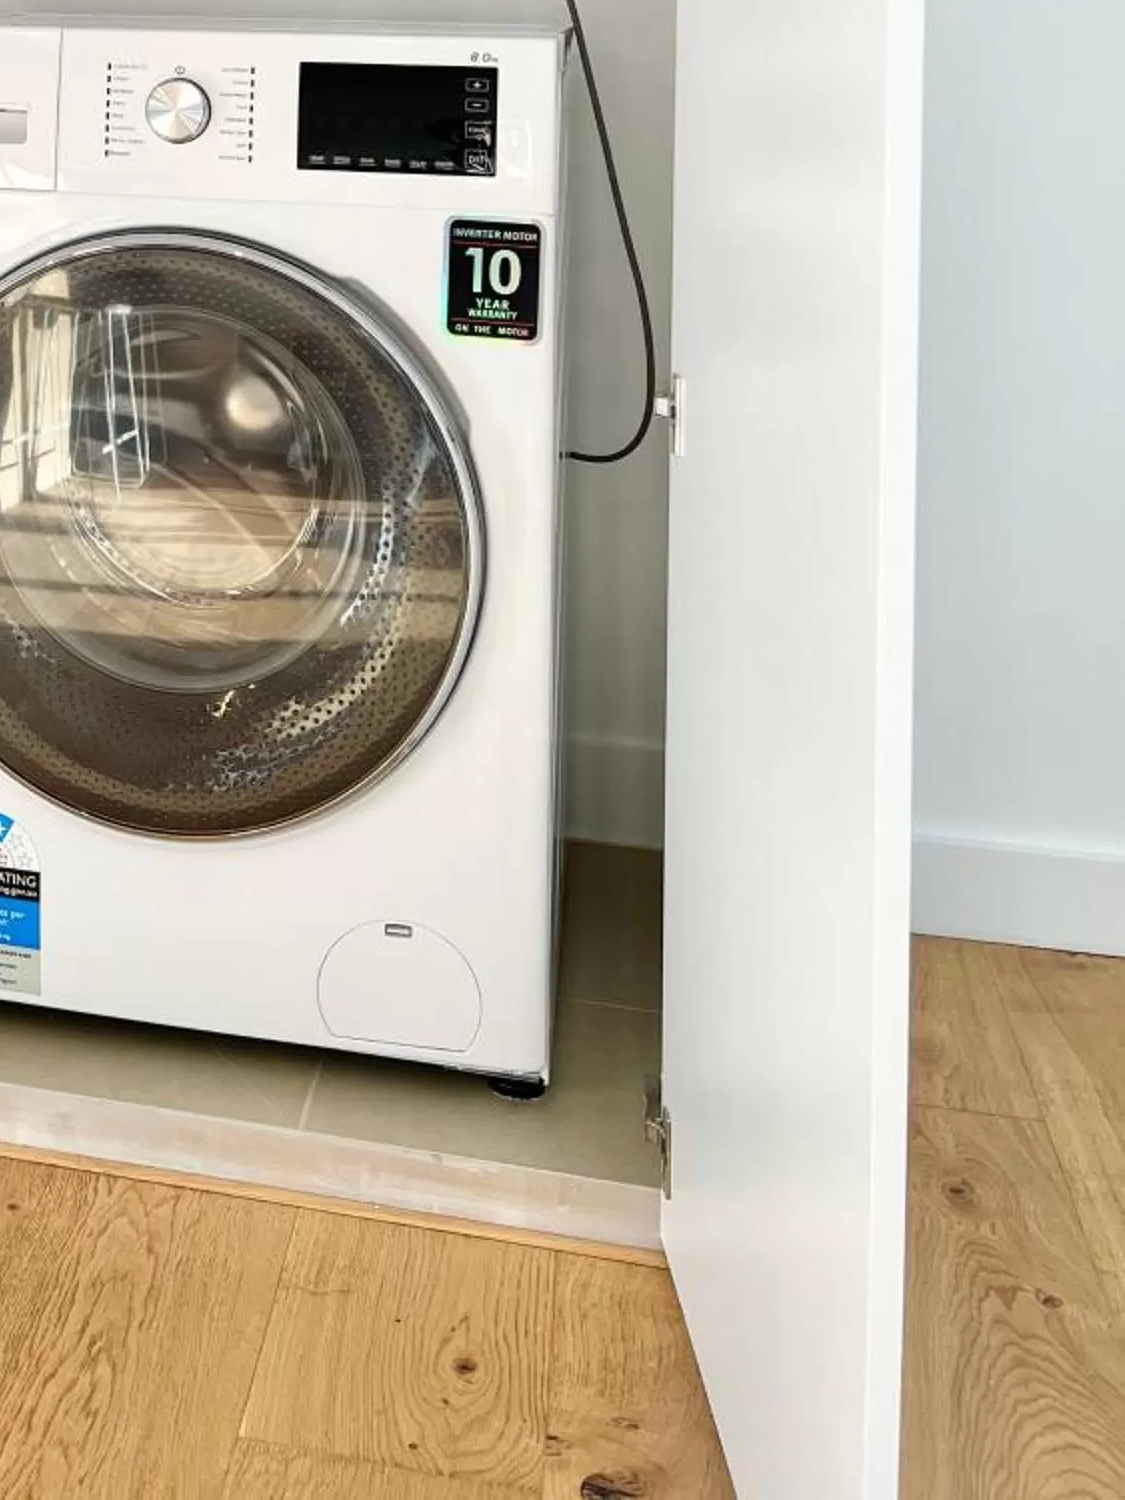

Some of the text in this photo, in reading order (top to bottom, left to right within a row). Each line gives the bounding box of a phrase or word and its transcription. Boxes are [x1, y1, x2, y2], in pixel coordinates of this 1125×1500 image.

[453, 228, 538, 242] INVERTER MOTOR
[465, 247, 522, 295] 10
[476, 298, 511, 310] YEAR
[468, 308, 517, 320] WARRANTY
[455, 324, 530, 337] ON THE MOTOR
